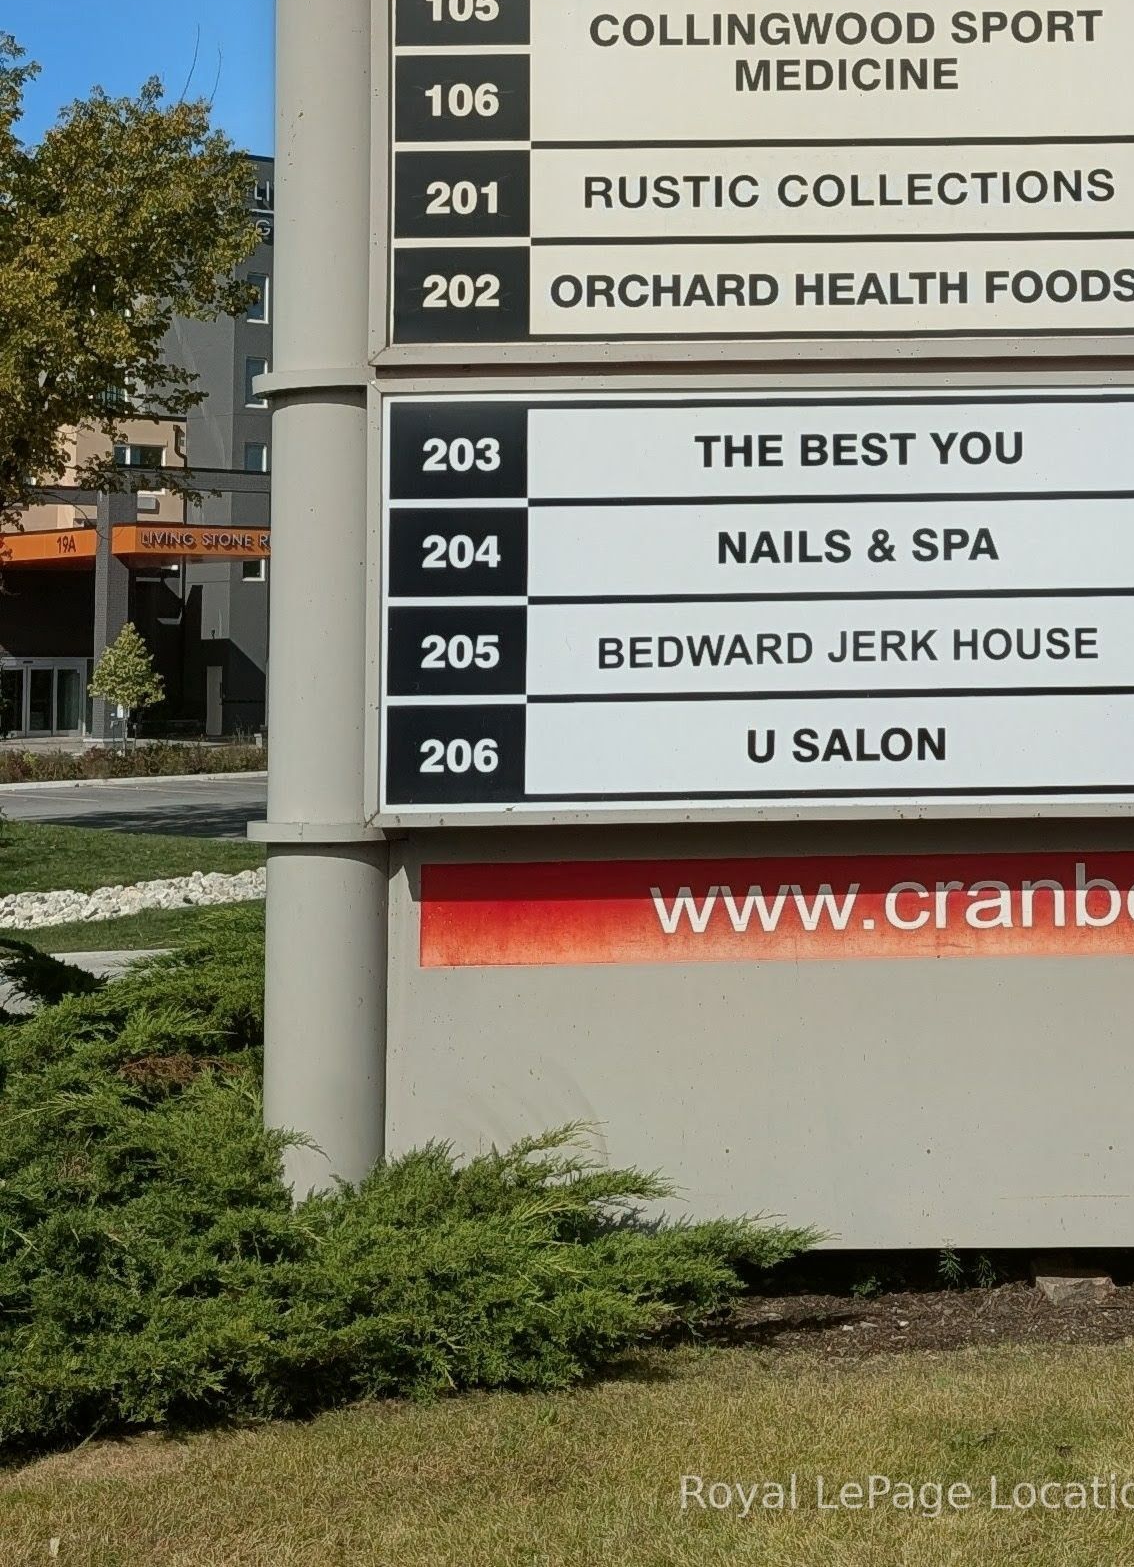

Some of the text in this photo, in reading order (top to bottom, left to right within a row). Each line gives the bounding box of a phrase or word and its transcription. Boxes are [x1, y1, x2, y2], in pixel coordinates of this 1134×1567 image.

[590, 10, 1103, 46] COLLINGWOOD SPORT
[736, 58, 958, 91] MEDICINE
[425, 83, 499, 116] 106
[426, 181, 497, 214] 201
[585, 169, 1114, 208] RUSTIC COLLECTIONS
[423, 274, 499, 307] 202
[551, 274, 778, 308] ORCHARD
[796, 272, 967, 305] HEALTH
[423, 438, 500, 471] 203
[695, 432, 1022, 467] THE BEST YOU
[57, 535, 76, 553] 19A
[140, 532, 194, 546] LIVING
[201, 533, 251, 547] STONE
[422, 535, 500, 568] 204
[719, 528, 999, 564] NAILS & SPA
[421, 635, 499, 668] 205
[599, 628, 1098, 669] BEDWARD JERK HOUSE
[420, 739, 498, 772] 206
[748, 728, 945, 763] U SALON
